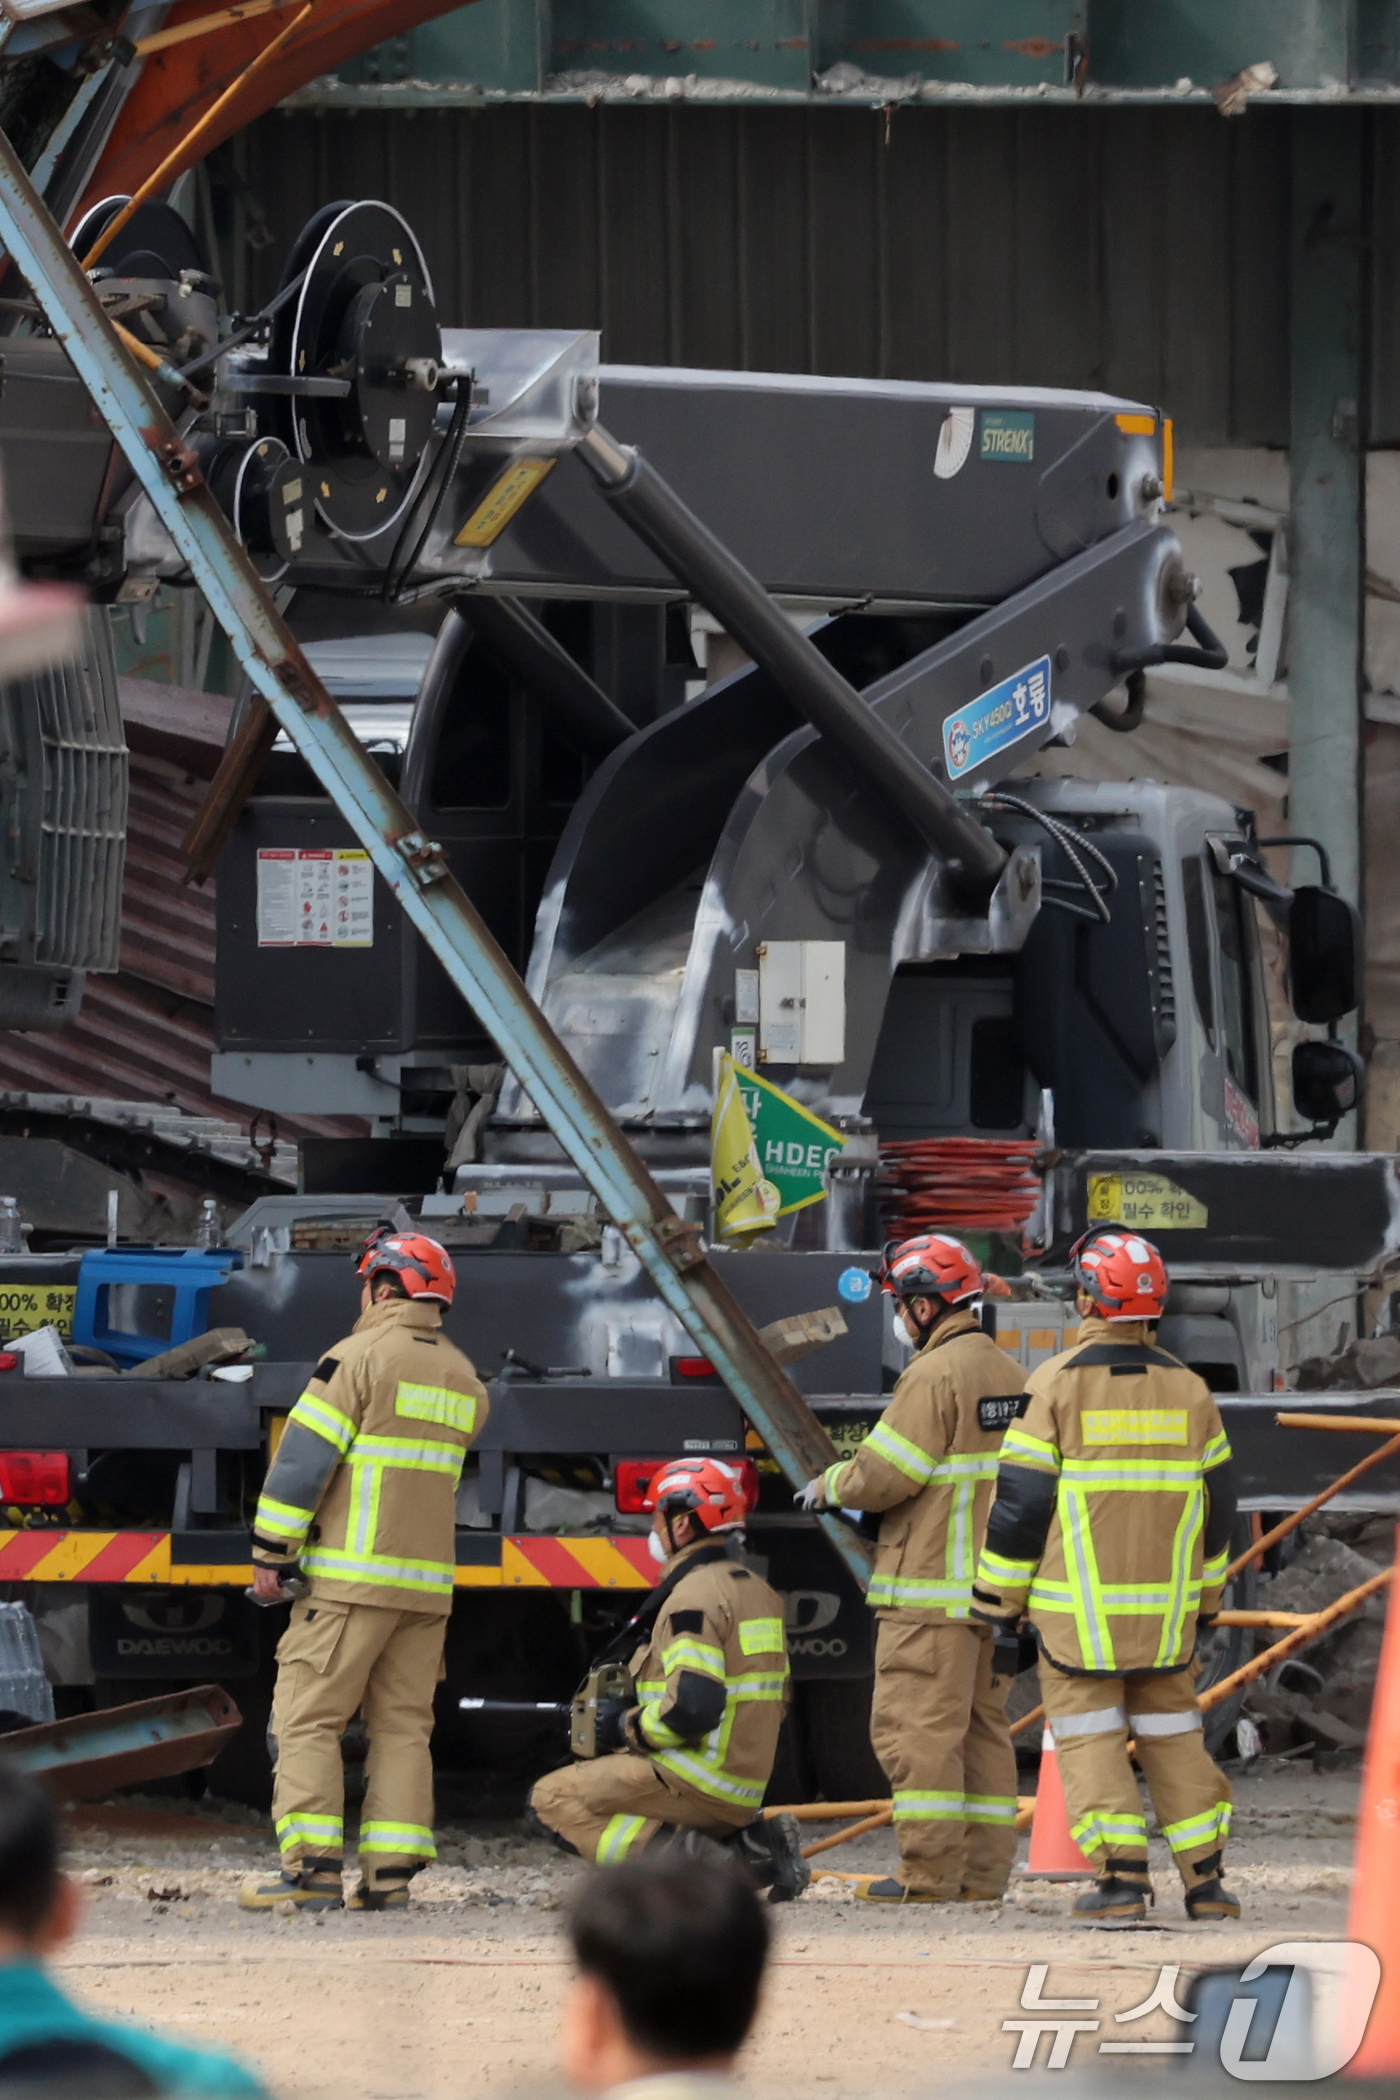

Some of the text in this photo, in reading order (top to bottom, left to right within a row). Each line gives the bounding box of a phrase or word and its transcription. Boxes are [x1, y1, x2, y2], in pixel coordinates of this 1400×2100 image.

[981, 428, 1029, 453] STRENX
[1012, 670, 1046, 727] 호룡
[117, 1639, 232, 1655] DAEWOO
